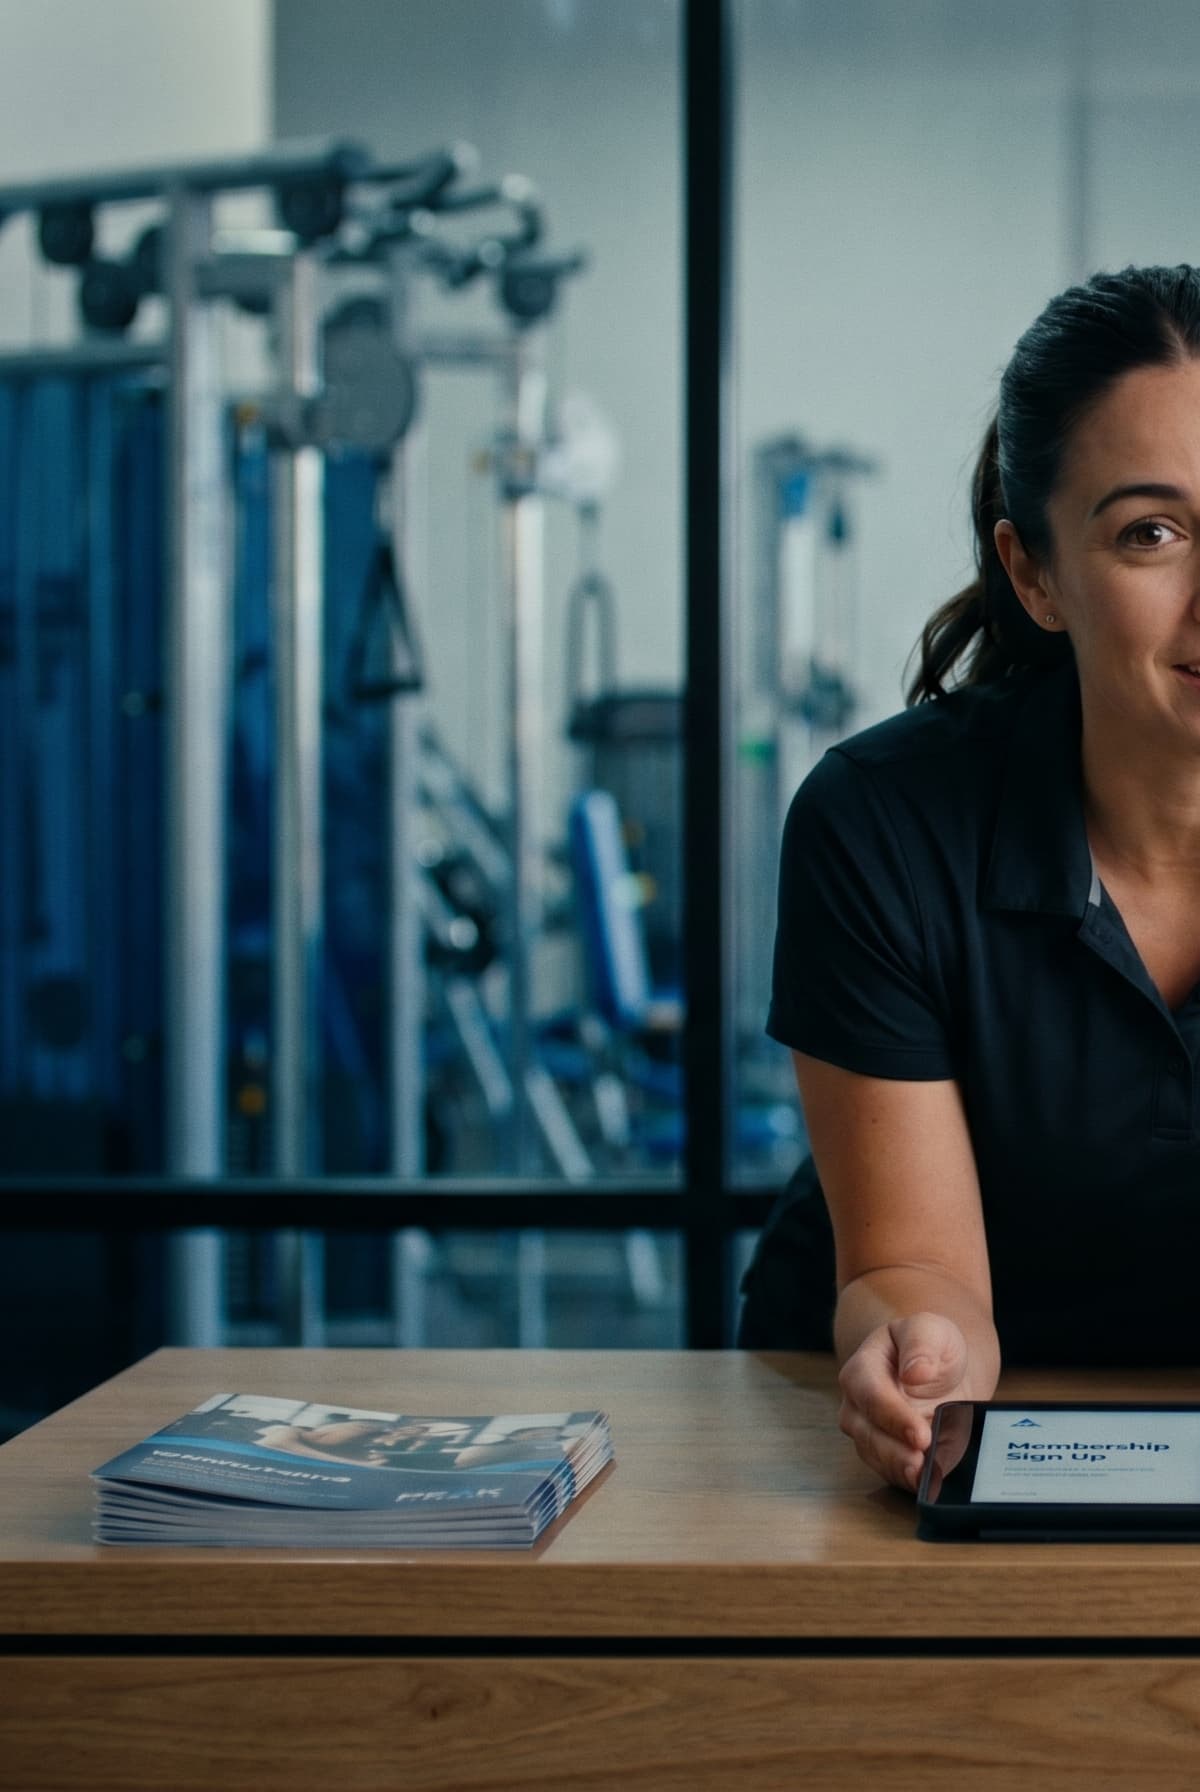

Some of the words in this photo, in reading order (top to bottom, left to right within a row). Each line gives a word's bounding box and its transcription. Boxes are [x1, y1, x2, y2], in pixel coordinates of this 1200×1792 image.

[1007, 1442, 1170, 1452] Membership
[1006, 1452, 1063, 1462] Sign
[1071, 1453, 1107, 1462] Up
